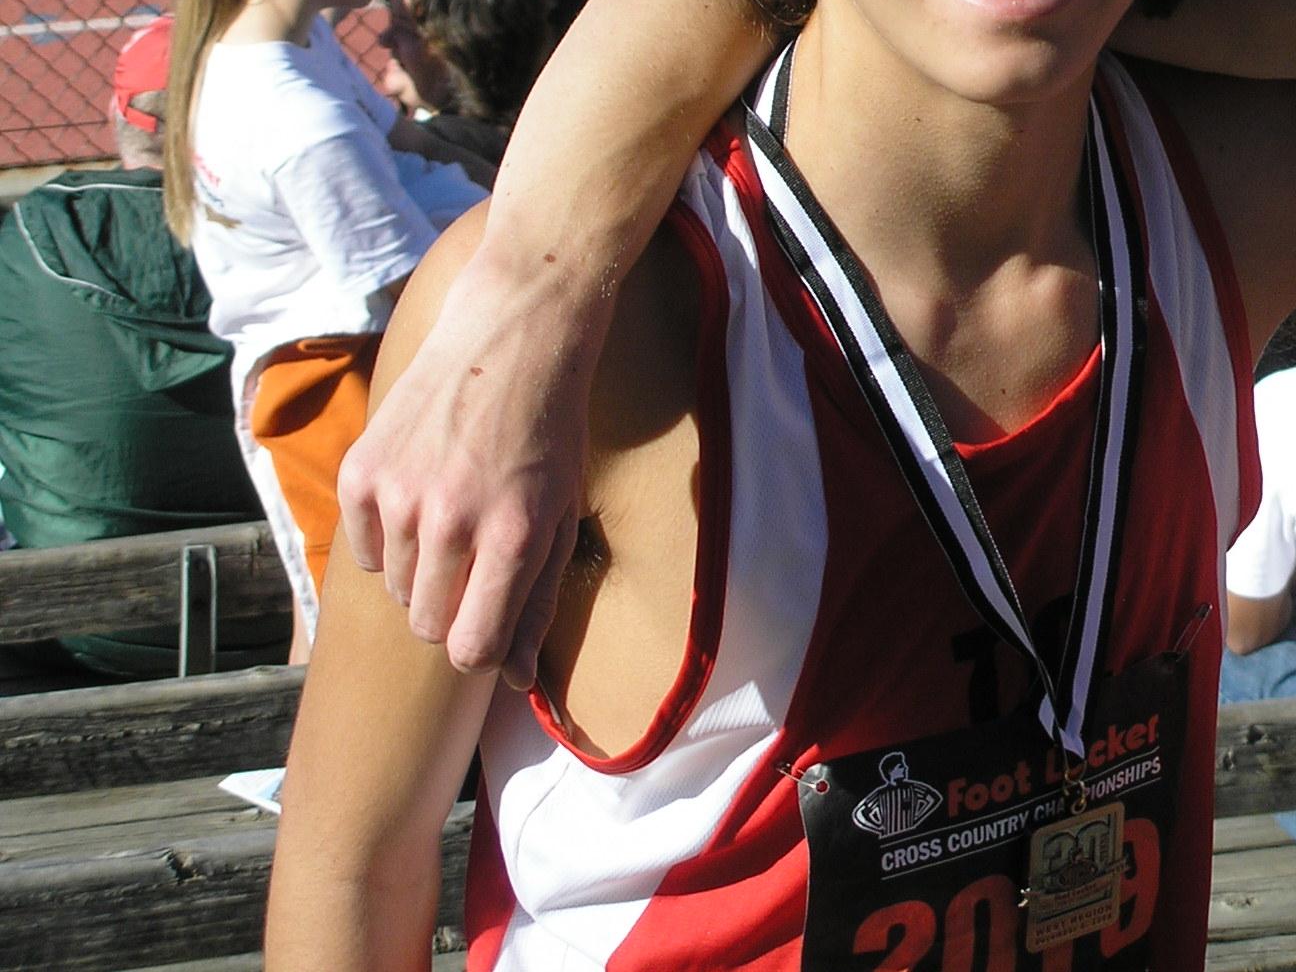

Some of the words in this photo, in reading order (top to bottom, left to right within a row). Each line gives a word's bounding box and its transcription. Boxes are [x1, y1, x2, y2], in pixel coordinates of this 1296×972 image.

[881, 838, 943, 872] CROSS
[947, 808, 1030, 854] COUNTRY
[1033, 756, 1162, 822] CHAPIONSHIPS
[947, 760, 1031, 819] Foot
